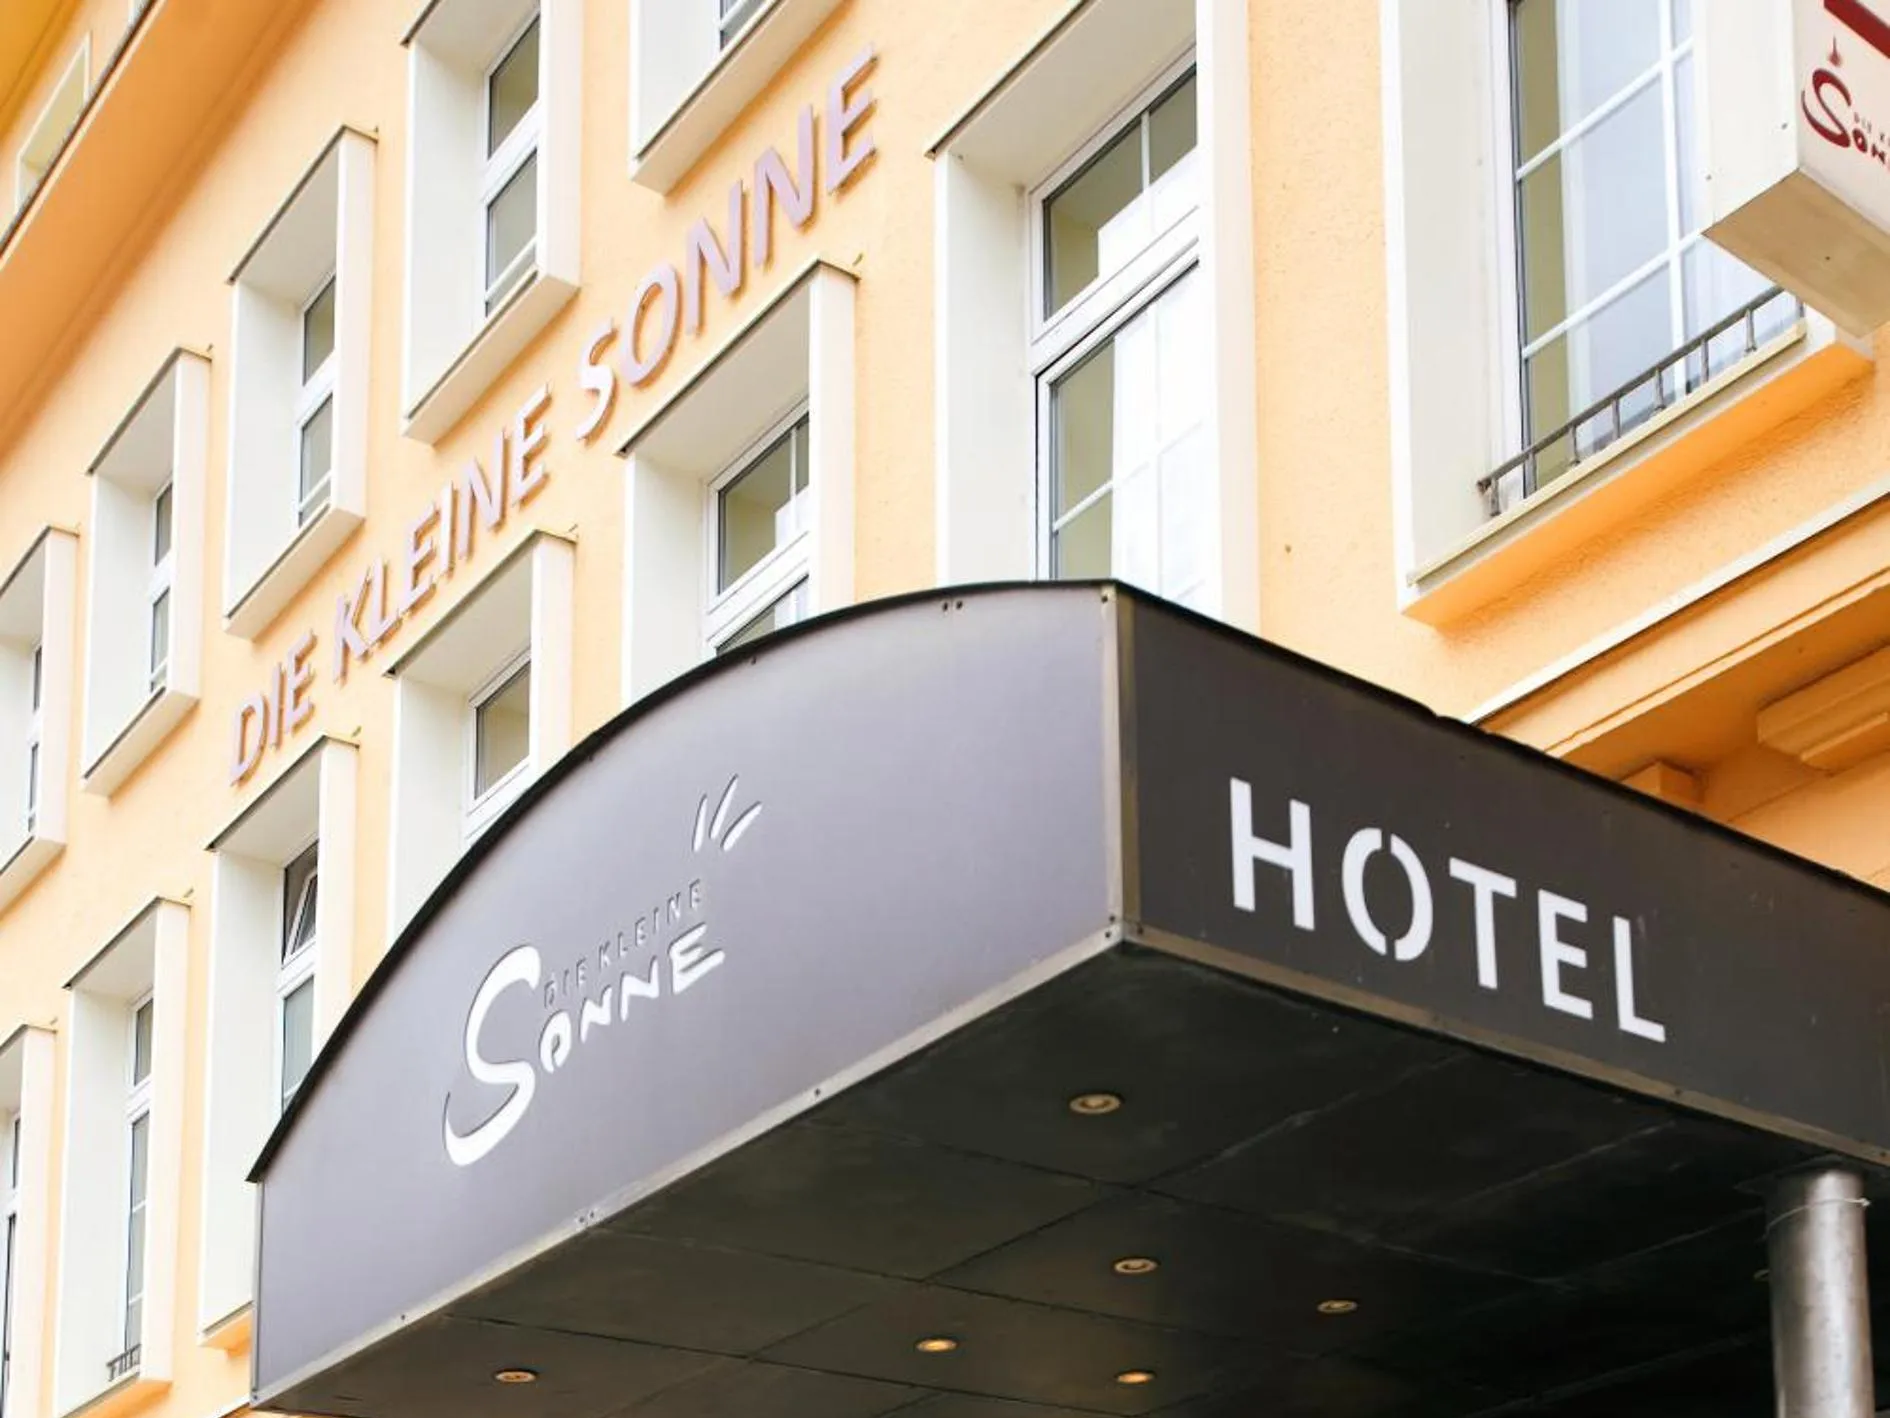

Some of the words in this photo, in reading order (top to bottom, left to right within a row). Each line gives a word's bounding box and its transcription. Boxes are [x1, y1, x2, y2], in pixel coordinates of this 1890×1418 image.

[230, 629, 317, 788] DIE
[333, 382, 553, 684] KLEINE
[575, 42, 880, 442] SONNE
[544, 956, 587, 1010] DIE
[598, 878, 703, 974] KLEINE
[1230, 776, 1666, 1044] HOTEL
[442, 921, 727, 1168] SONNE
